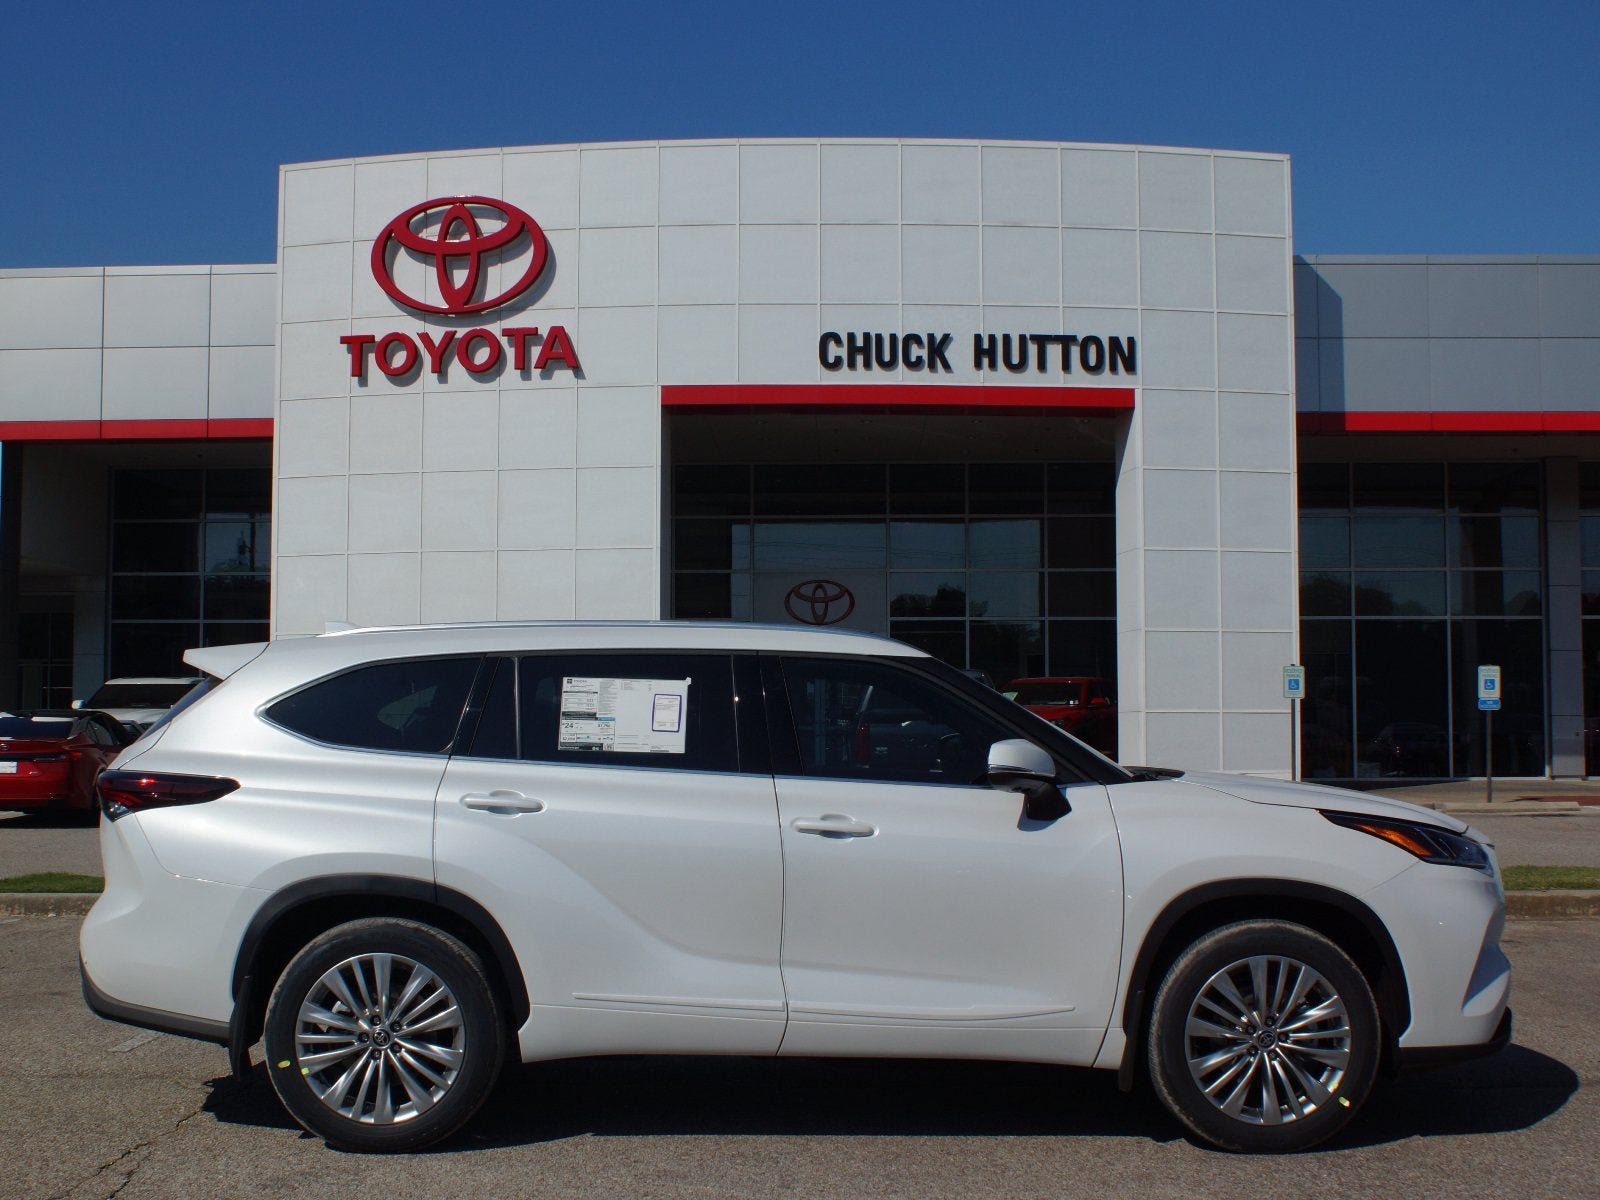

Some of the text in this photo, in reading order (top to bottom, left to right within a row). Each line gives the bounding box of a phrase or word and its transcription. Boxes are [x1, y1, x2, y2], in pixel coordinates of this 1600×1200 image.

[340, 326, 579, 377] TOYOTA
[818, 331, 1136, 374] CHUCK HUTTON
